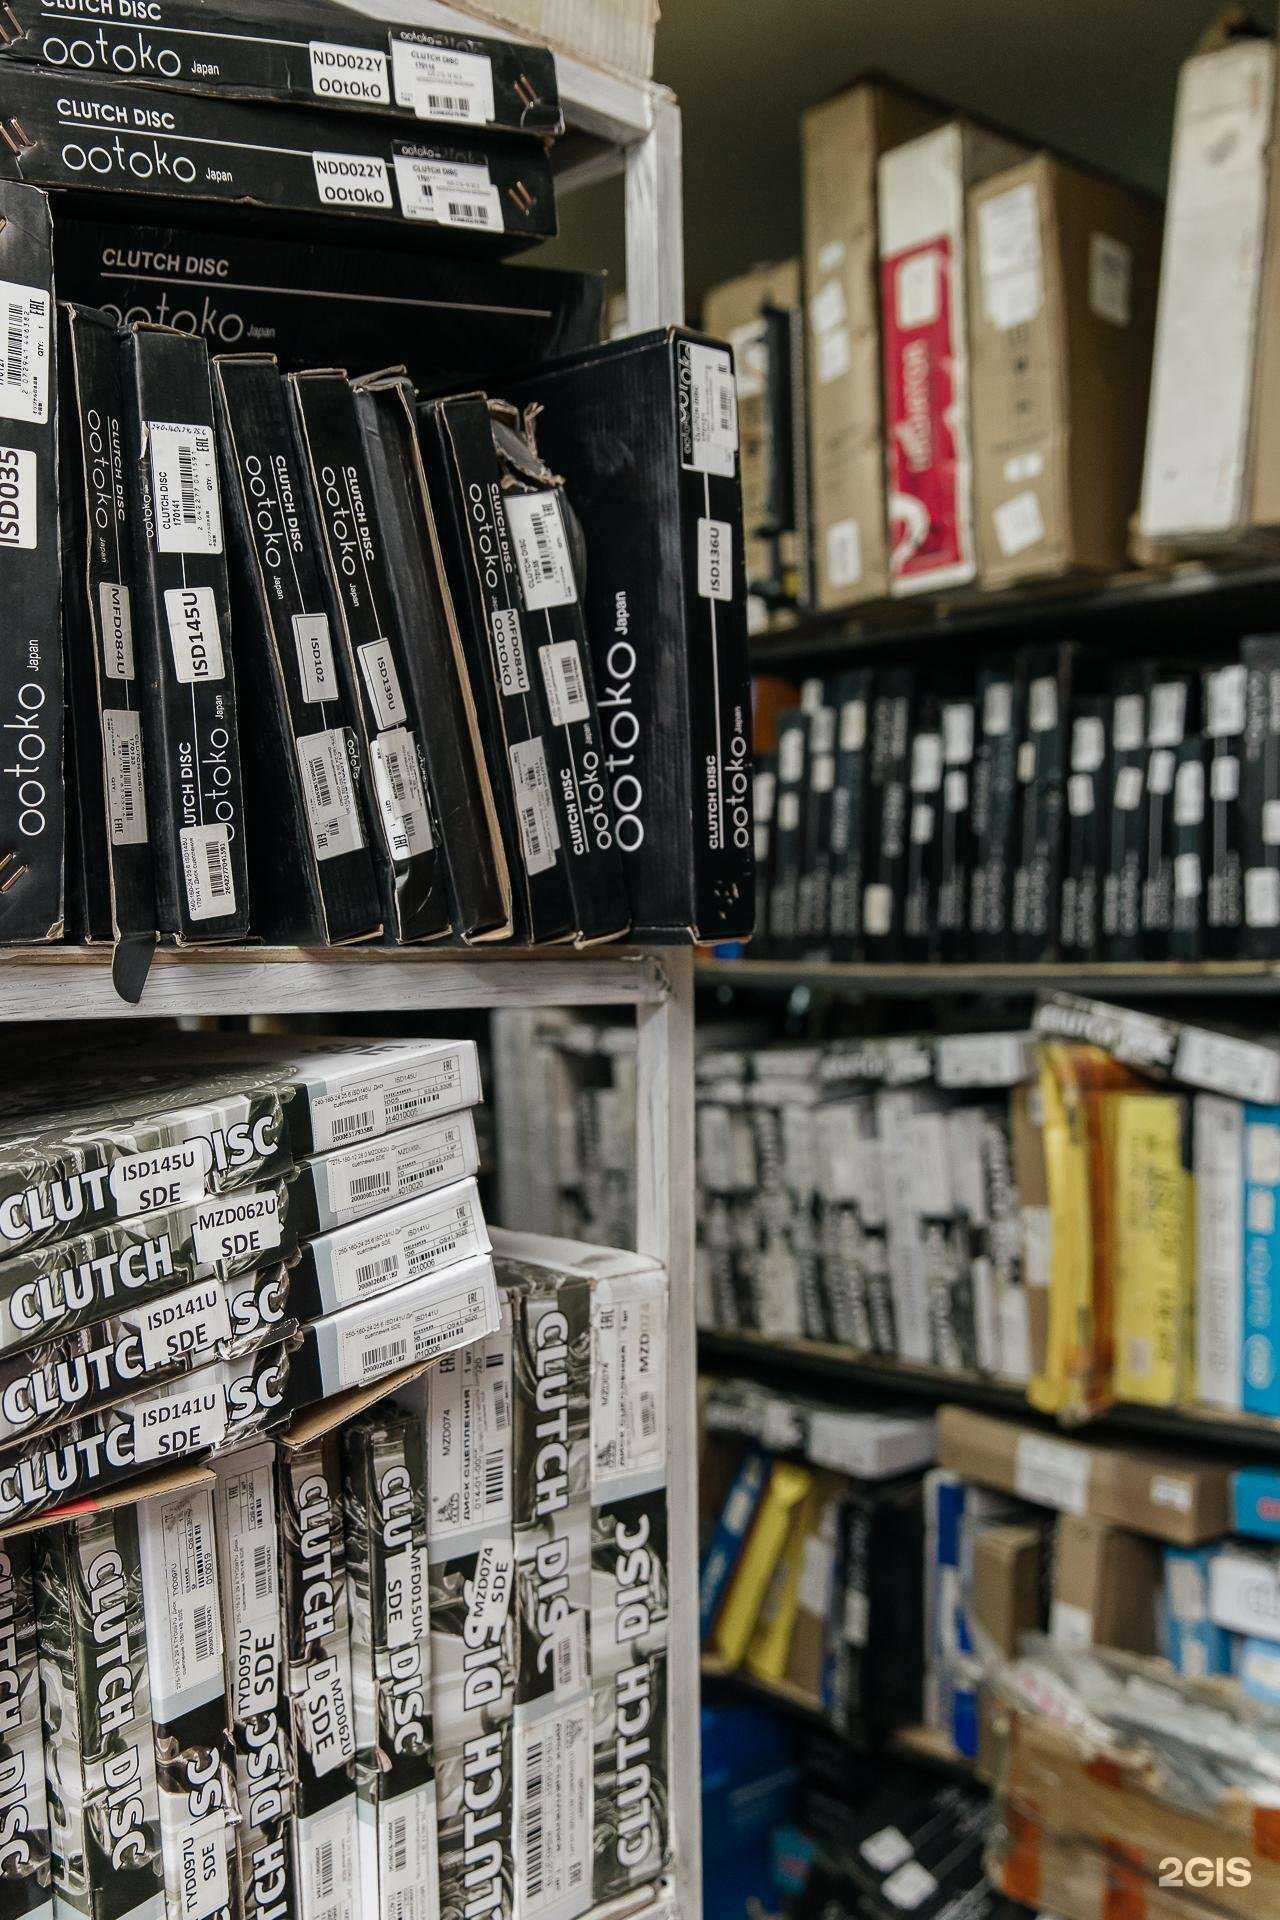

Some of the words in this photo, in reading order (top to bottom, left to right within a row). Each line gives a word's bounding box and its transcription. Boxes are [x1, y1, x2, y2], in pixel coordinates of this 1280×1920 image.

[120, 0, 161, 21] DISC
[43, 28, 181, 76] ootoko
[191, 61, 219, 76] Japan
[313, 50, 382, 72] NDD022Y
[57, 99, 127, 123] CLUTCH
[134, 108, 175, 130] DISC
[62, 135, 196, 182] ootoko
[205, 169, 233, 182] Japan
[316, 160, 382, 178] NDD022Y
[102, 248, 179, 272] CLUTCH
[186, 254, 229, 277] DISC
[246, 324, 275, 338] Japan
[88, 410, 108, 528] ootoko
[111, 418, 123, 485] CLUTCH
[159, 471, 168, 493] DISC
[116, 487, 126, 521] DISC
[161, 495, 171, 530] CLUTCH
[172, 500, 181, 526] 170141
[275, 455, 296, 514] CLUTCH
[346, 466, 368, 524] CLUTCH
[357, 526, 375, 561] DISC
[246, 455, 281, 567] ootoko
[273, 575, 284, 600] Japan
[284, 515, 303, 552] DISC
[322, 466, 356, 576] ootoko
[349, 583, 359, 607] Japan
[469, 483, 498, 588] ootoko
[491, 483, 506, 537] CLUTCH
[501, 541, 512, 573] DISC
[711, 527, 720, 592] ISD136U
[112, 587, 125, 675] MFD084U
[185, 590, 209, 677] ISD145U
[614, 590, 628, 636] Japan
[27, 639, 39, 672] Japan
[310, 637, 325, 683] ISD102
[507, 611, 526, 689] MFD084U
[215, 695, 224, 720] Japan
[377, 656, 396, 710] ISD139U
[3, 683, 45, 836] ootoko
[180, 741, 192, 784] DISC
[597, 641, 644, 852] ootoko
[706, 754, 716, 788] DISC
[560, 768, 575, 803] DISC
[580, 751, 612, 850] ootoko
[724, 736, 748, 848] ootoko
[566, 804, 583, 856] CLUTCH
[708, 790, 719, 850] CLUTCH
[122, 1151, 195, 1182] ISD145U
[139, 1181, 181, 1212] SDE
[0, 1166, 117, 1241] CLUT
[198, 1198, 277, 1231] MZD062U
[221, 1230, 261, 1258] SDE
[9, 1235, 175, 1330] CLUTCH
[147, 1290, 218, 1331] ISD141U
[2, 1336, 145, 1424] CLUTC
[228, 1282, 285, 1336] SC
[166, 1323, 208, 1356] SDE
[0, 1423, 135, 1513] CLUTC
[227, 1366, 284, 1421] SC
[142, 1394, 217, 1428] ISD141U
[158, 1426, 202, 1456] SDE
[536, 1311, 569, 1517] CLUTCH
[381, 1465, 414, 1551] CLU
[299, 1474, 336, 1643] CLUTCH
[474, 1548, 493, 1617] MZD074
[492, 1562, 509, 1603] SDE
[615, 1514, 651, 1644] DISC
[387, 1579, 402, 1624] SDE
[87, 1548, 138, 1736] CLUTCH
[238, 1628, 252, 1716] TYD097U
[254, 1633, 275, 1697] SDE
[463, 1579, 503, 1711] DIS
[308, 1694, 334, 1755] SDE
[331, 1678, 353, 1756] MZD062U
[389, 1643, 425, 1755] DISC
[187, 1747, 224, 1819] SC
[245, 1711, 282, 1829] DISC
[616, 1662, 652, 1869] CLUTCH
[101, 1745, 146, 1872] DISC
[183, 1837, 199, 1912] TYD097U
[202, 1842, 216, 1882] SDE
